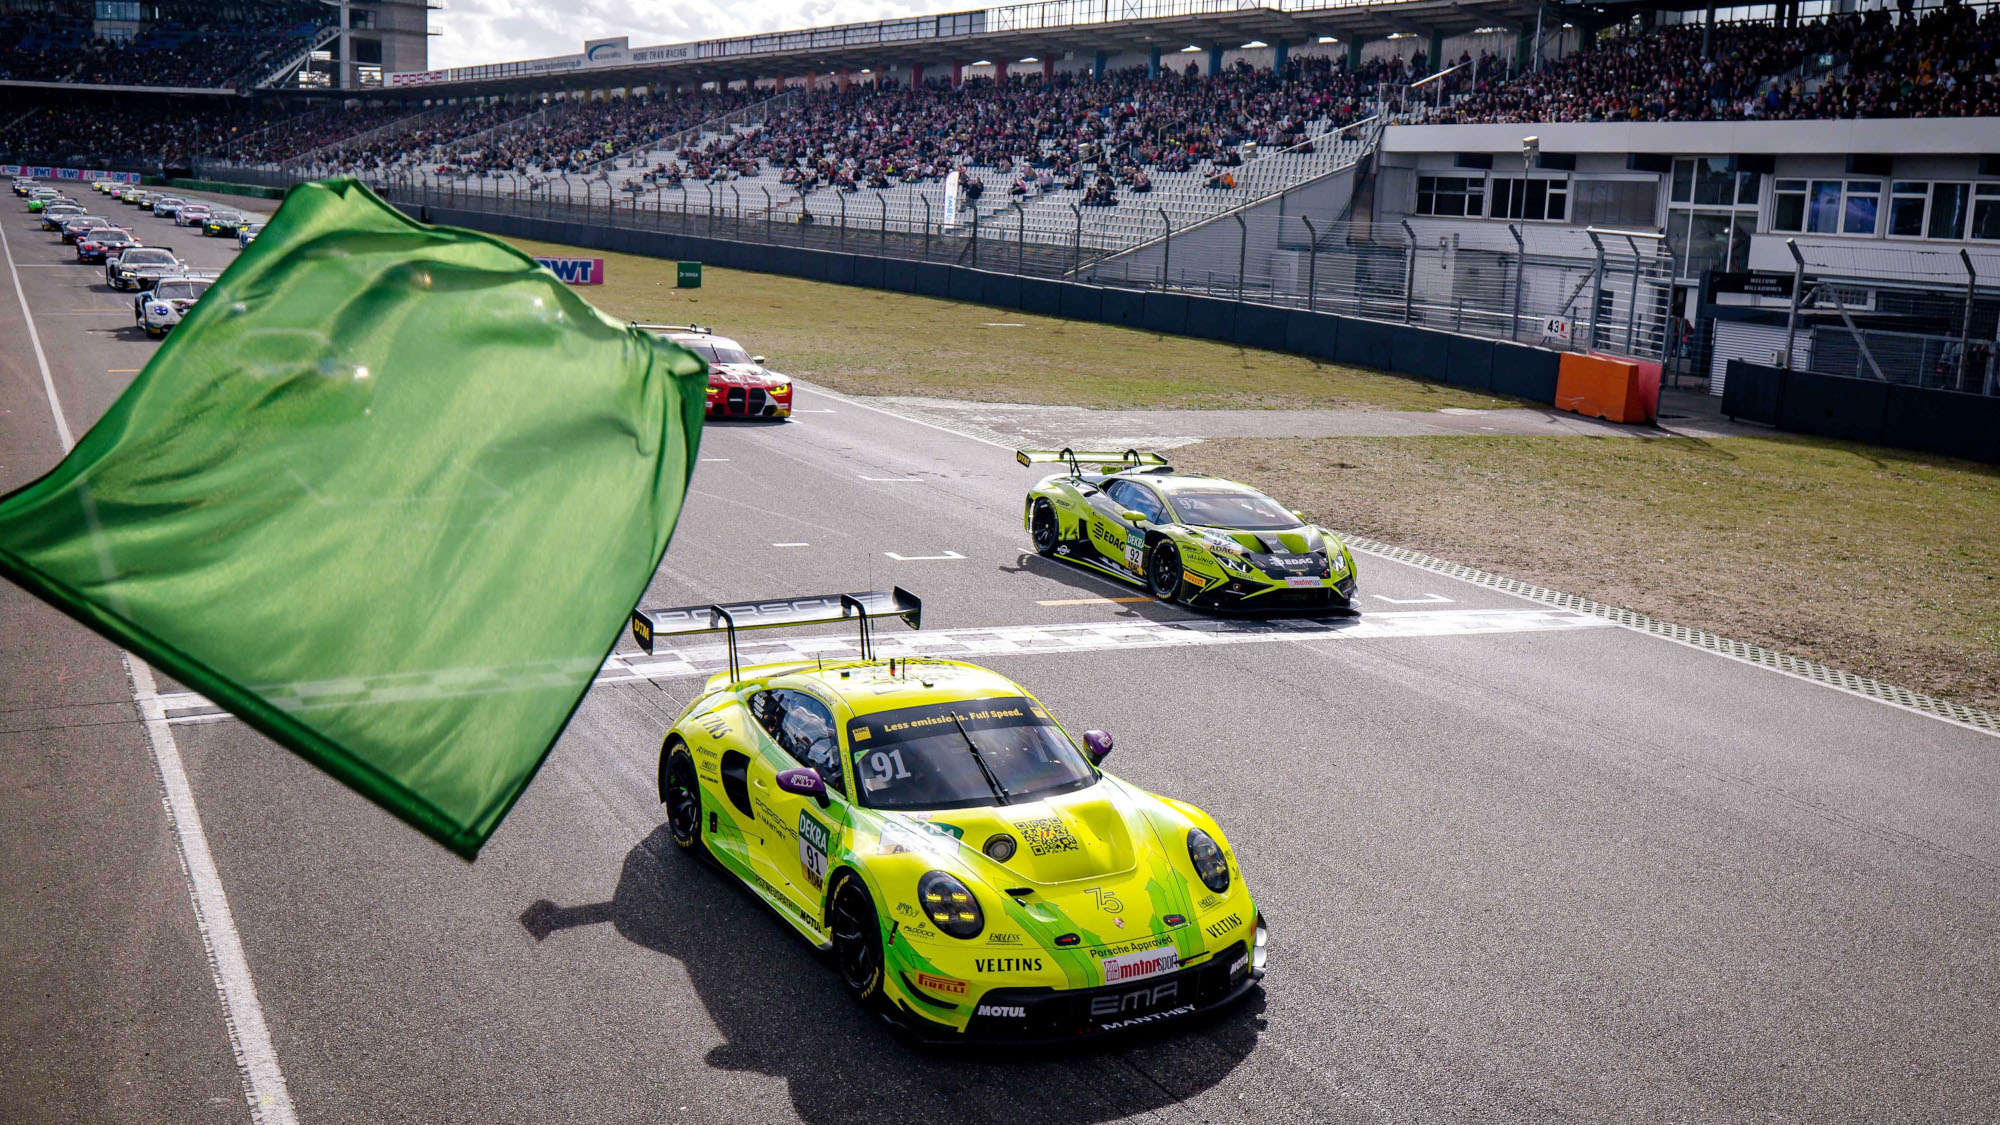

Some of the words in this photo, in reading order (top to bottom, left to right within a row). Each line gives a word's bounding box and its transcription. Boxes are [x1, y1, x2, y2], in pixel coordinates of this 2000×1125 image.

[633, 51, 648, 62] MORE
[649, 50, 664, 60] THAN
[665, 47, 688, 59] RACING
[392, 71, 442, 86] PORSCHE
[1744, 284, 1783, 292] WILLKOMMEN
[1547, 319, 1560, 336] 43
[1017, 453, 1030, 468] DTM
[1103, 531, 1126, 552] EDAG
[1209, 545, 1234, 555] ADAC
[1130, 548, 1140, 563] 92
[1286, 557, 1313, 565] EDAG
[634, 618, 650, 641] DTM
[884, 722, 910, 733] Less
[911, 713, 969, 727] emissios.
[970, 710, 989, 720] Full
[990, 708, 1024, 720] Speed.
[870, 749, 911, 783] 91
[755, 797, 798, 841] PORSCHE
[799, 813, 828, 853] DEKRA
[806, 844, 822, 877] 91
[1083, 887, 1124, 914] 75
[1197, 894, 1216, 909] ENDLESS
[800, 909, 822, 934] MOTUL
[903, 925, 936, 938] PADDOCK
[1205, 913, 1243, 938] VELTINS
[988, 933, 1020, 942] ENDLESS
[1089, 944, 1130, 959] Porsche
[1131, 935, 1174, 953] Approved
[975, 958, 1043, 973] VELTINS
[918, 973, 966, 994] PIRELLI
[1091, 980, 1178, 1015] EMA
[977, 1004, 1026, 1018] MOTUL
[1100, 1003, 1196, 1030] MANTHEY
